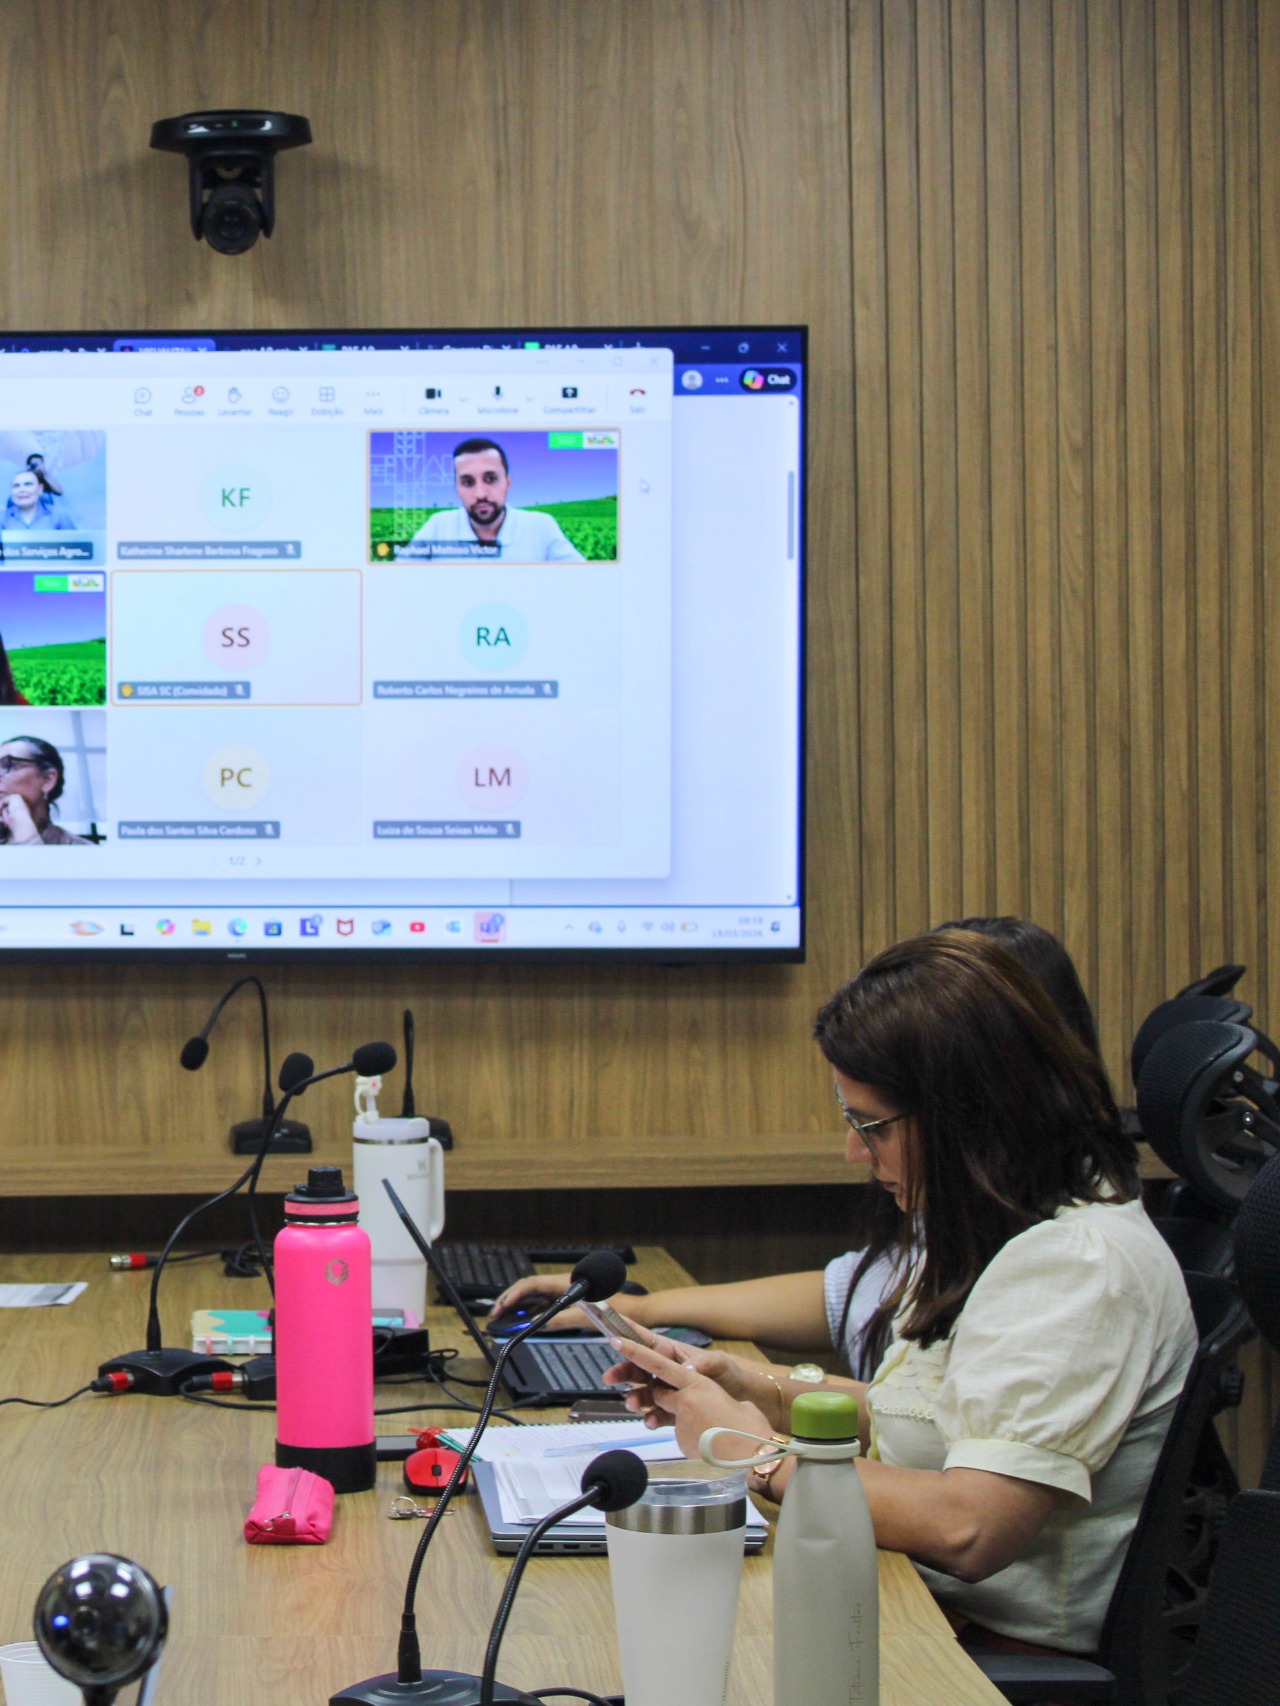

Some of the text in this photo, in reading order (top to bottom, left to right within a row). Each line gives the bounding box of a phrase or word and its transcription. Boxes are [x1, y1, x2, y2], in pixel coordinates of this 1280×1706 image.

[767, 374, 791, 385] Chat
[477, 407, 519, 415] Microfone
[221, 487, 252, 508] KF
[221, 627, 251, 648] SS
[476, 626, 511, 647] RA
[220, 768, 252, 788] PC
[475, 767, 511, 787] LM
